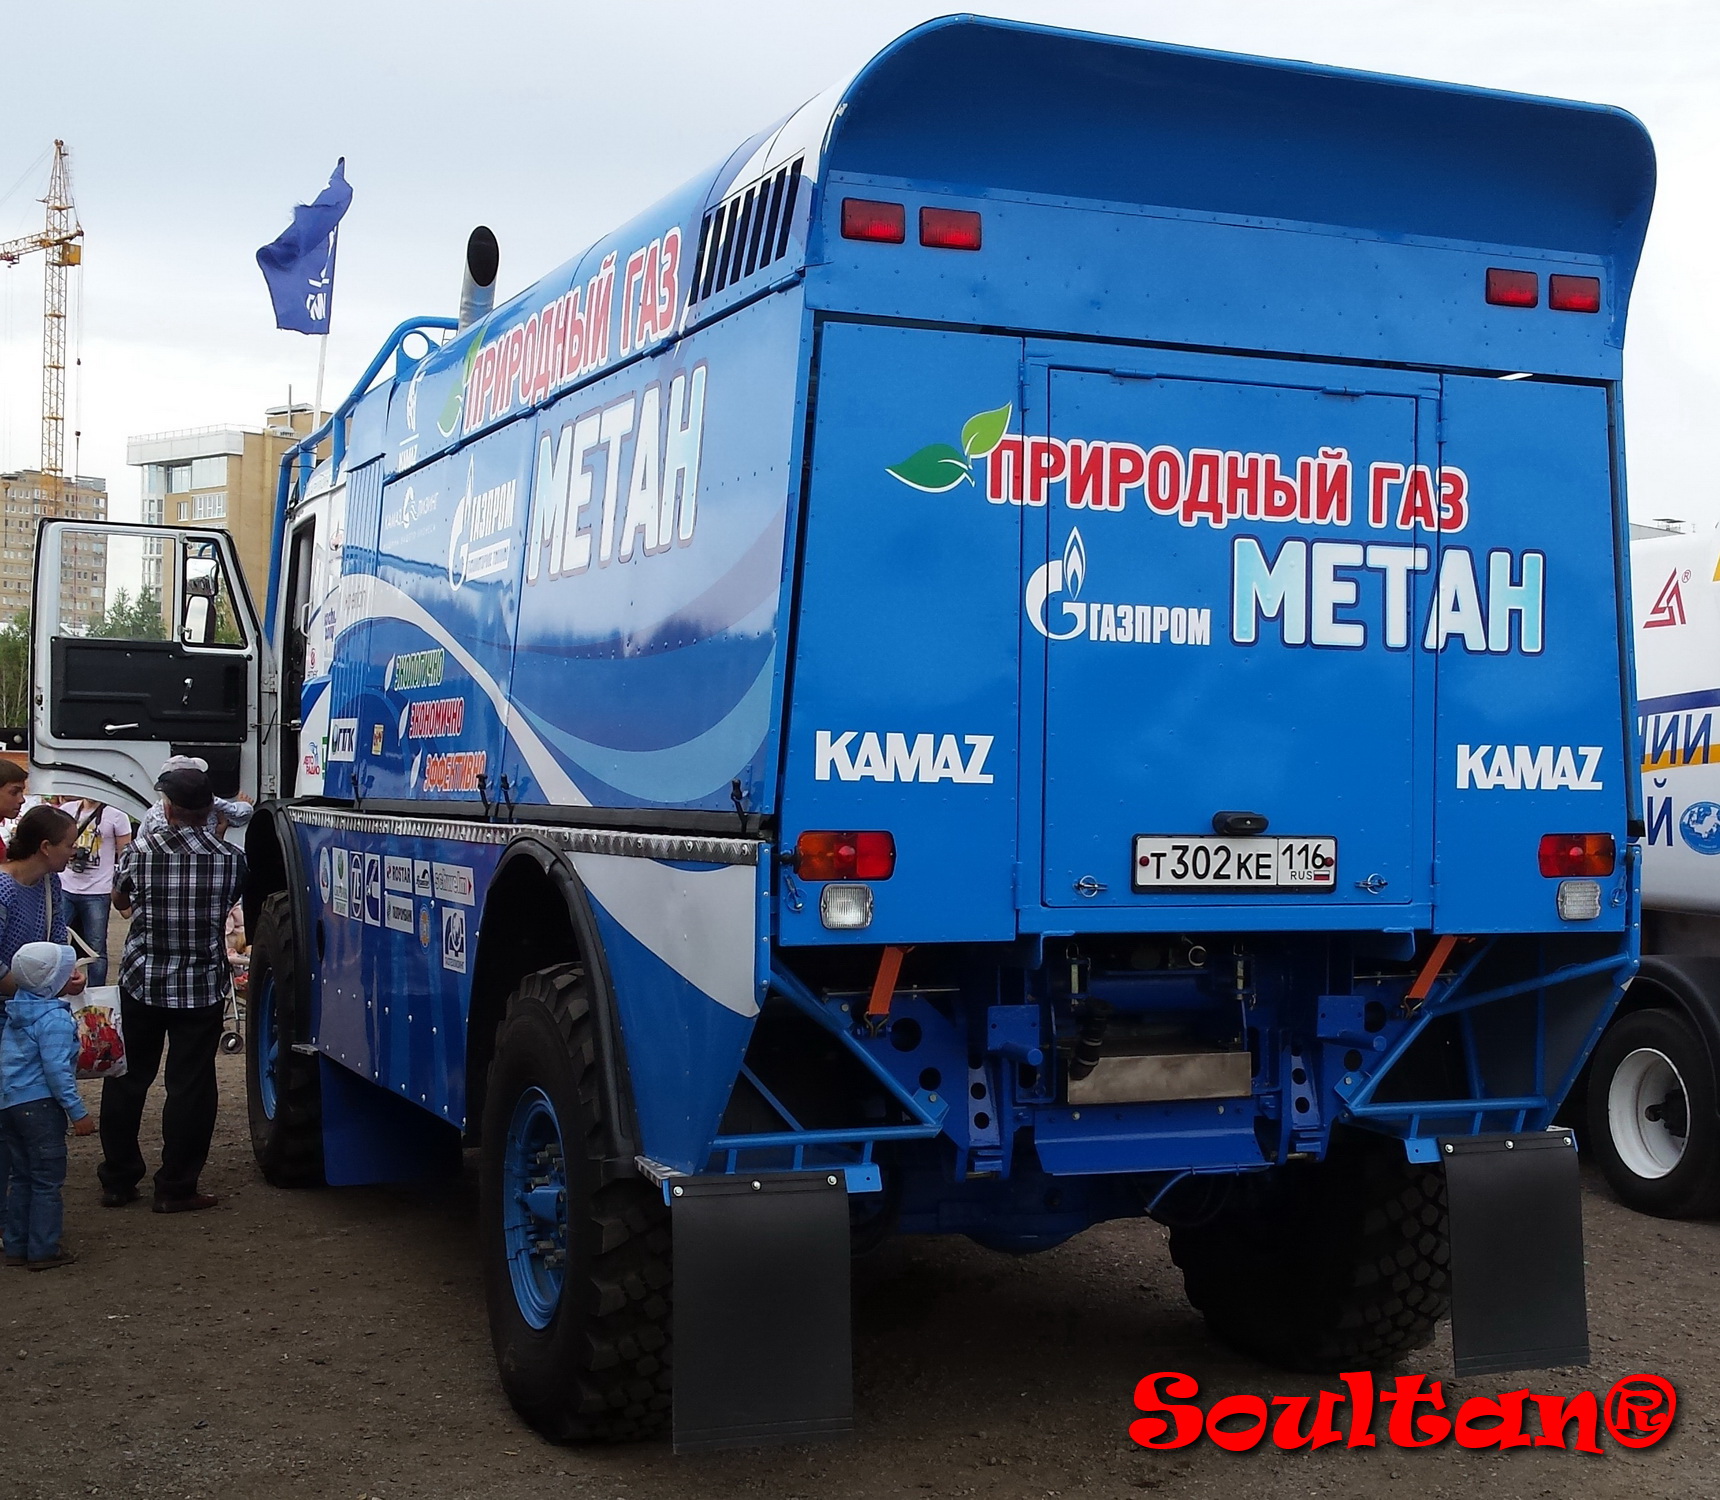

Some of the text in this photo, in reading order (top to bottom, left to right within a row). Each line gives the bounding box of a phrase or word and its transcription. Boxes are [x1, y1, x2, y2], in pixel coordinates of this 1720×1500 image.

[463, 226, 681, 436] ПРИРОДНЫЙ ГАЗ
[526, 363, 708, 584] МЕТАН
[987, 433, 1469, 534] ПРИРОДНЫЙ ГАЗ
[470, 480, 515, 542] ГАЗПРОМ
[1232, 536, 1545, 654] МЕТАН
[1089, 602, 1211, 646] ГАЗПРОМ
[394, 647, 445, 692] ЭКОЛОГИЧНО
[408, 696, 465, 739] ЭКОНОМИЧНО
[423, 750, 487, 792] ЭФФЕКТИВНО
[813, 730, 995, 784] KAMAZ
[1455, 744, 1604, 791] KAMAZ
[391, 865, 411, 884] ROSTAR
[1150, 843, 1326, 880] Т302КЕ 116
[1290, 871, 1313, 881] RUS
